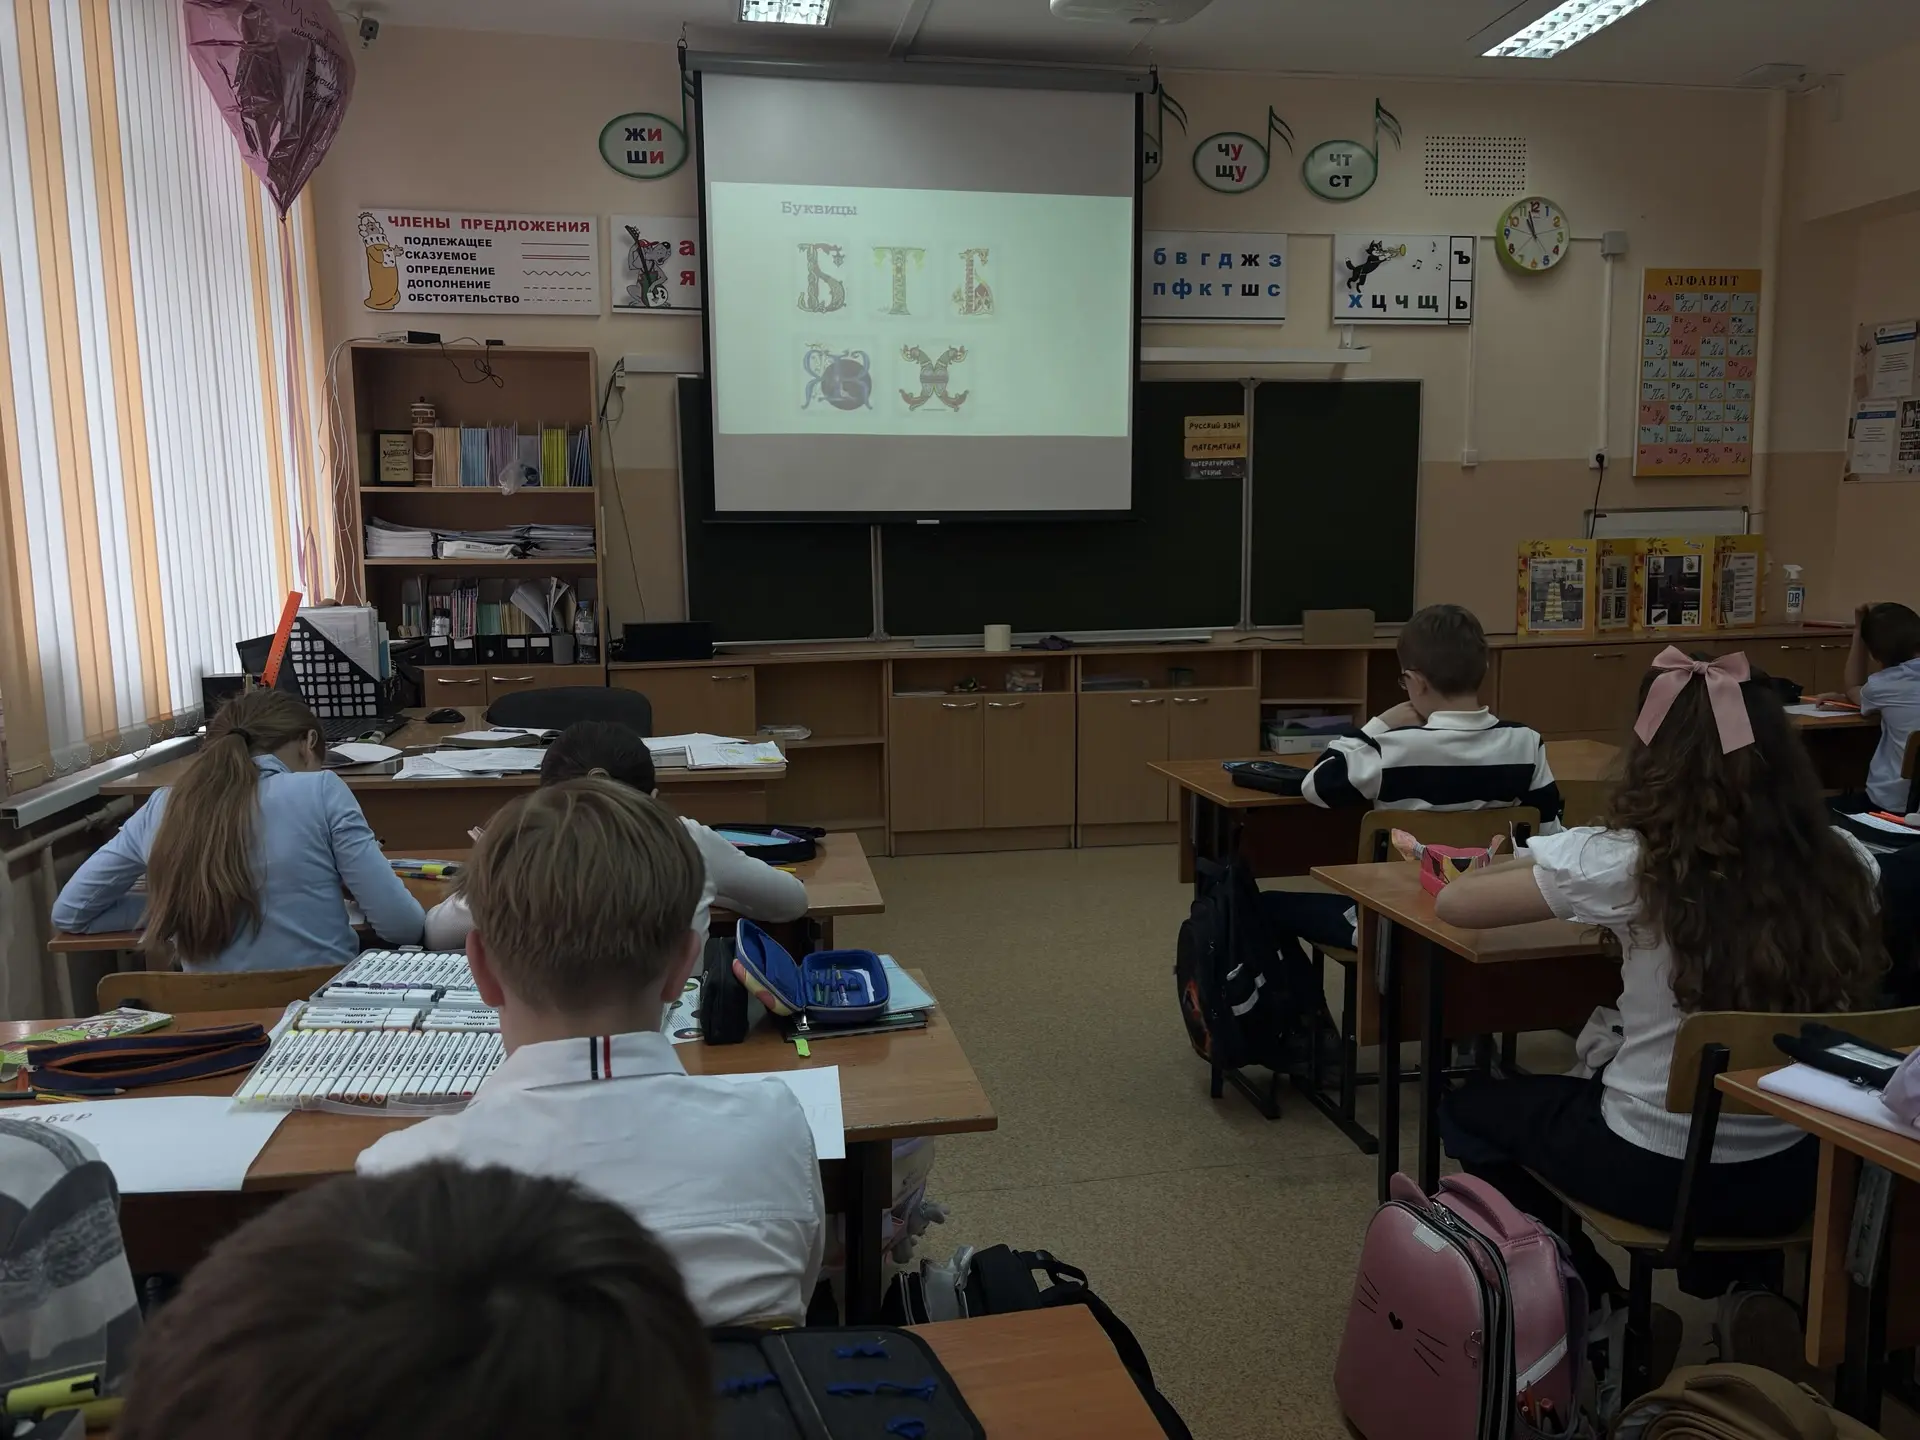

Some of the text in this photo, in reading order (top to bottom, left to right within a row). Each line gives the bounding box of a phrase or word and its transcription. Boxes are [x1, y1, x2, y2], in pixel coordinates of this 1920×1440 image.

[1218, 144, 1244, 160] чу
[1216, 164, 1246, 182] щу
[781, 202, 858, 216] Буквицы
[1530, 202, 1540, 212] 12
[388, 216, 590, 232] ЧЛЕНЫ ПРЕДЛОЖЕНИЯ
[1553, 216, 1560, 227] 2
[404, 236, 492, 248] ПОДЛЕЖАЩЕЕ
[679, 240, 696, 255] а
[405, 250, 477, 261] СКАЗУЕМОЕ
[1154, 248, 1166, 265] б
[1176, 252, 1187, 264] в
[1201, 253, 1210, 265] г
[1218, 254, 1232, 269] д
[406, 264, 496, 276] ОПРЕДЕЛЕНИЕ
[407, 278, 491, 290] ДОПОЛНЕНИЕ
[1664, 275, 1739, 286] АЛФАВИТ
[1153, 282, 1166, 295] п
[1172, 278, 1192, 299] ф
[408, 293, 520, 304] ОБСТОЯТЕЛЬСТВО
[1192, 443, 1240, 452] МАТЕМАТИКА
[1788, 592, 1800, 603] DR
